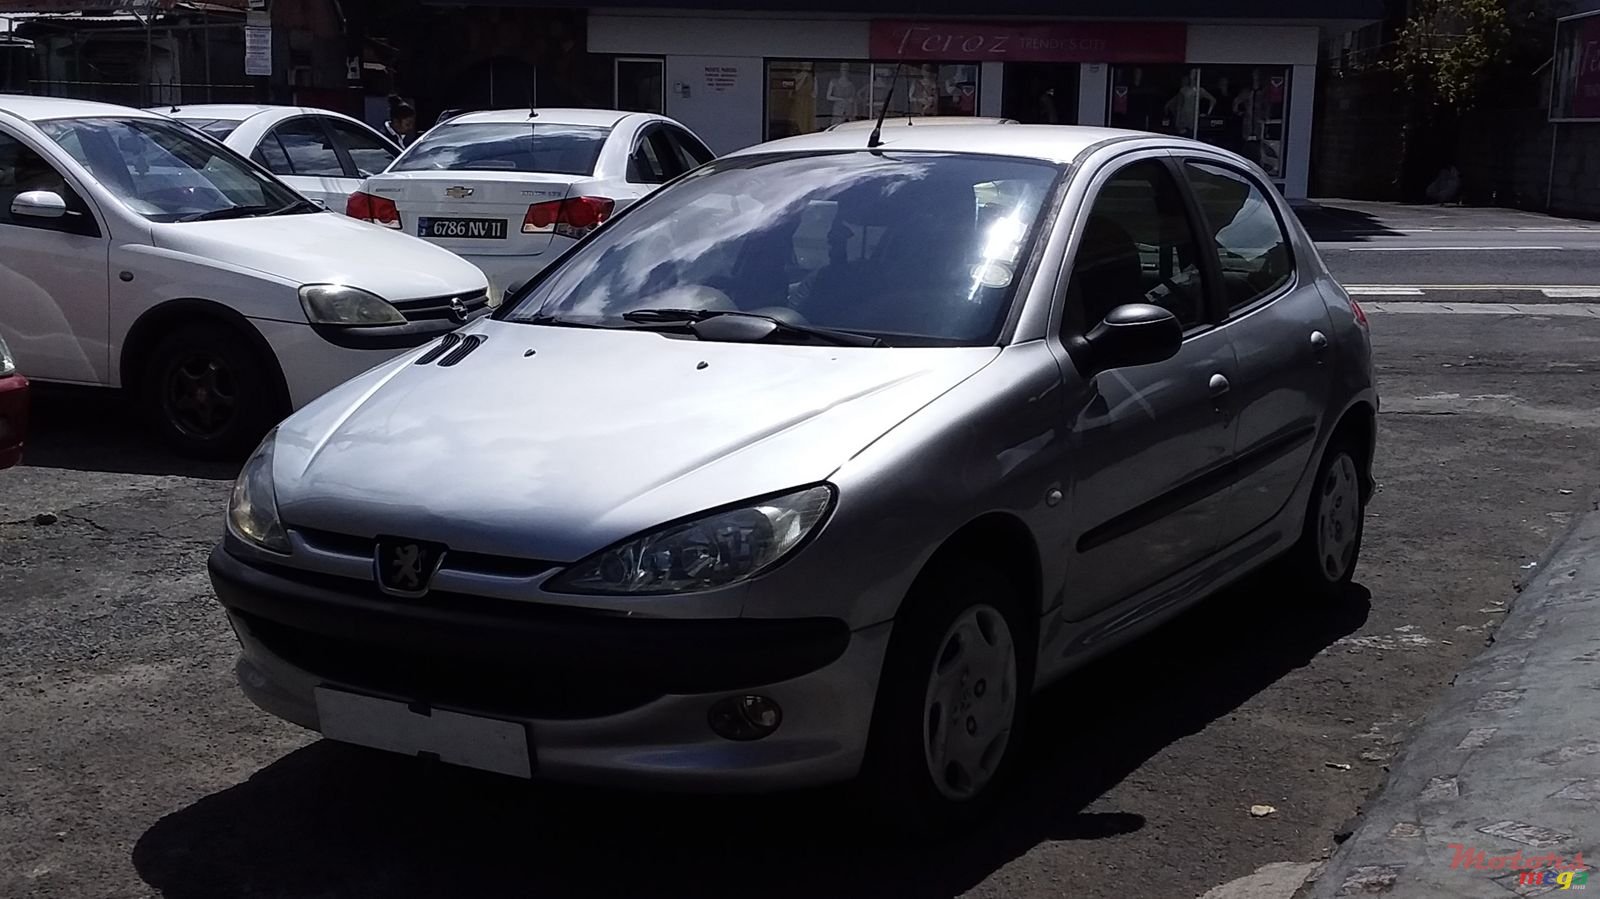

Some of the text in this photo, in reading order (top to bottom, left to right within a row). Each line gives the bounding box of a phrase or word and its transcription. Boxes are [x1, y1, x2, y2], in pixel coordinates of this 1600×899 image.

[897, 26, 1009, 54] Feroz
[434, 220, 466, 236] 6786
[468, 221, 488, 237] NV
